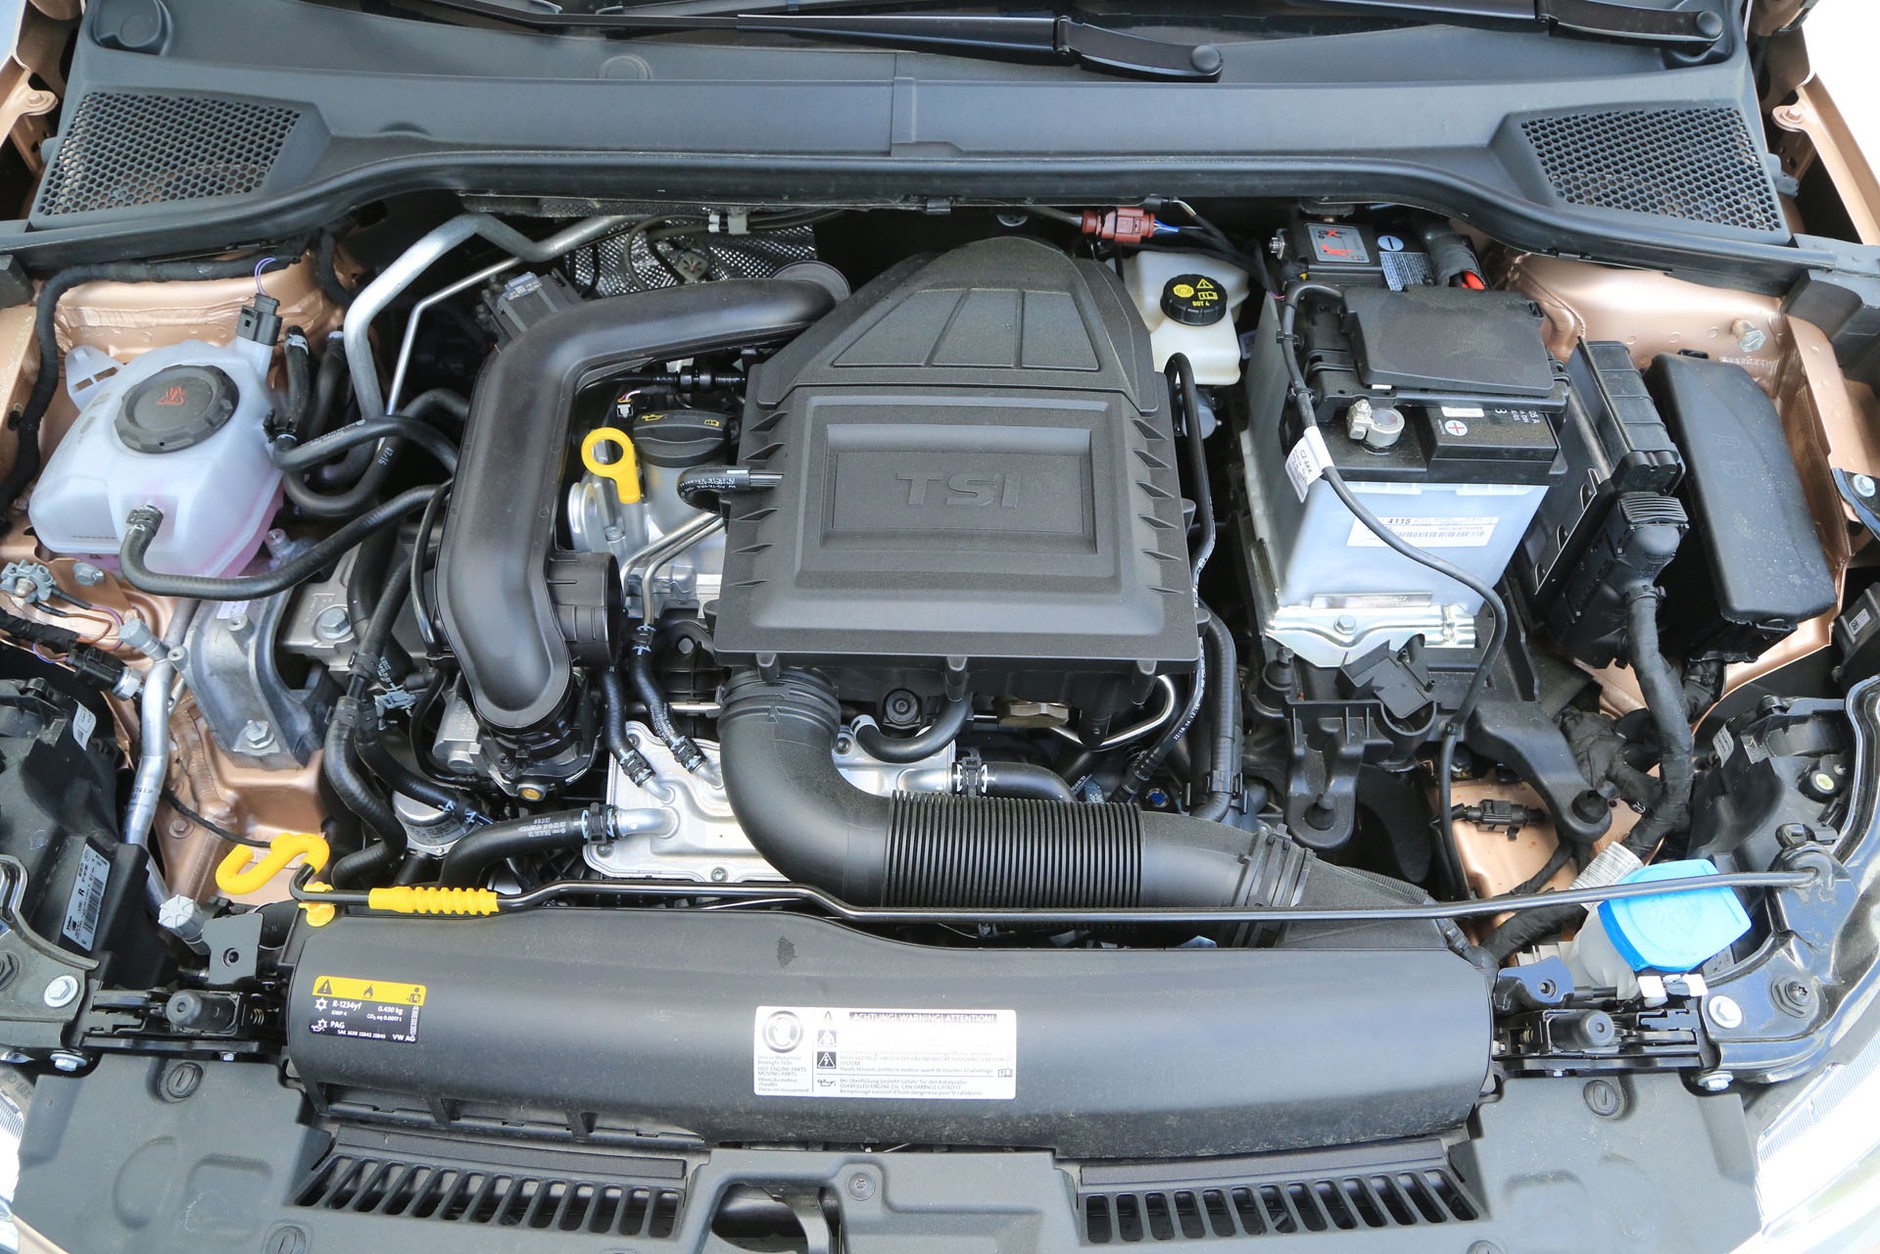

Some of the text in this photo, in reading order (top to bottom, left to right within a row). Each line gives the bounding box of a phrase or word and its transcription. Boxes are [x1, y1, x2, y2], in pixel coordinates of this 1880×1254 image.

[895, 472, 1021, 508] TSI
[332, 1000, 362, 1012] R-1234yf
[330, 1020, 345, 1029] PAG
